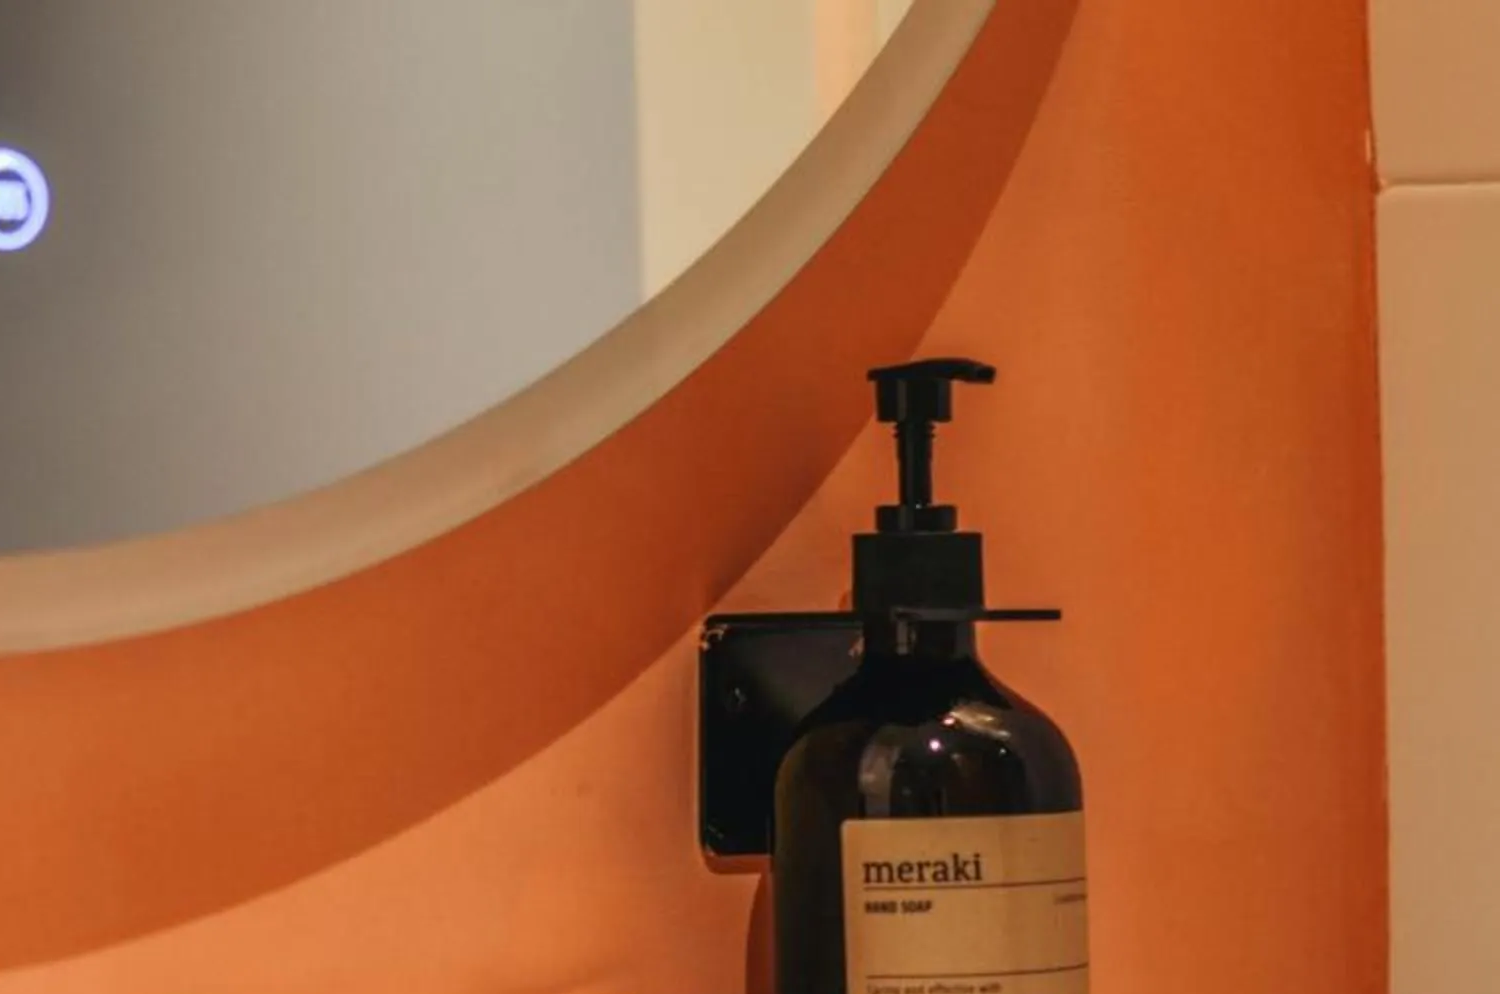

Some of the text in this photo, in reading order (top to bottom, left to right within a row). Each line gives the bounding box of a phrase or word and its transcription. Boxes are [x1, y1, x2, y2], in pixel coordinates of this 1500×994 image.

[863, 853, 982, 884] meraki
[864, 900, 932, 914] HAND SOAP
[927, 982, 974, 994] effective
[979, 982, 1002, 994] with
